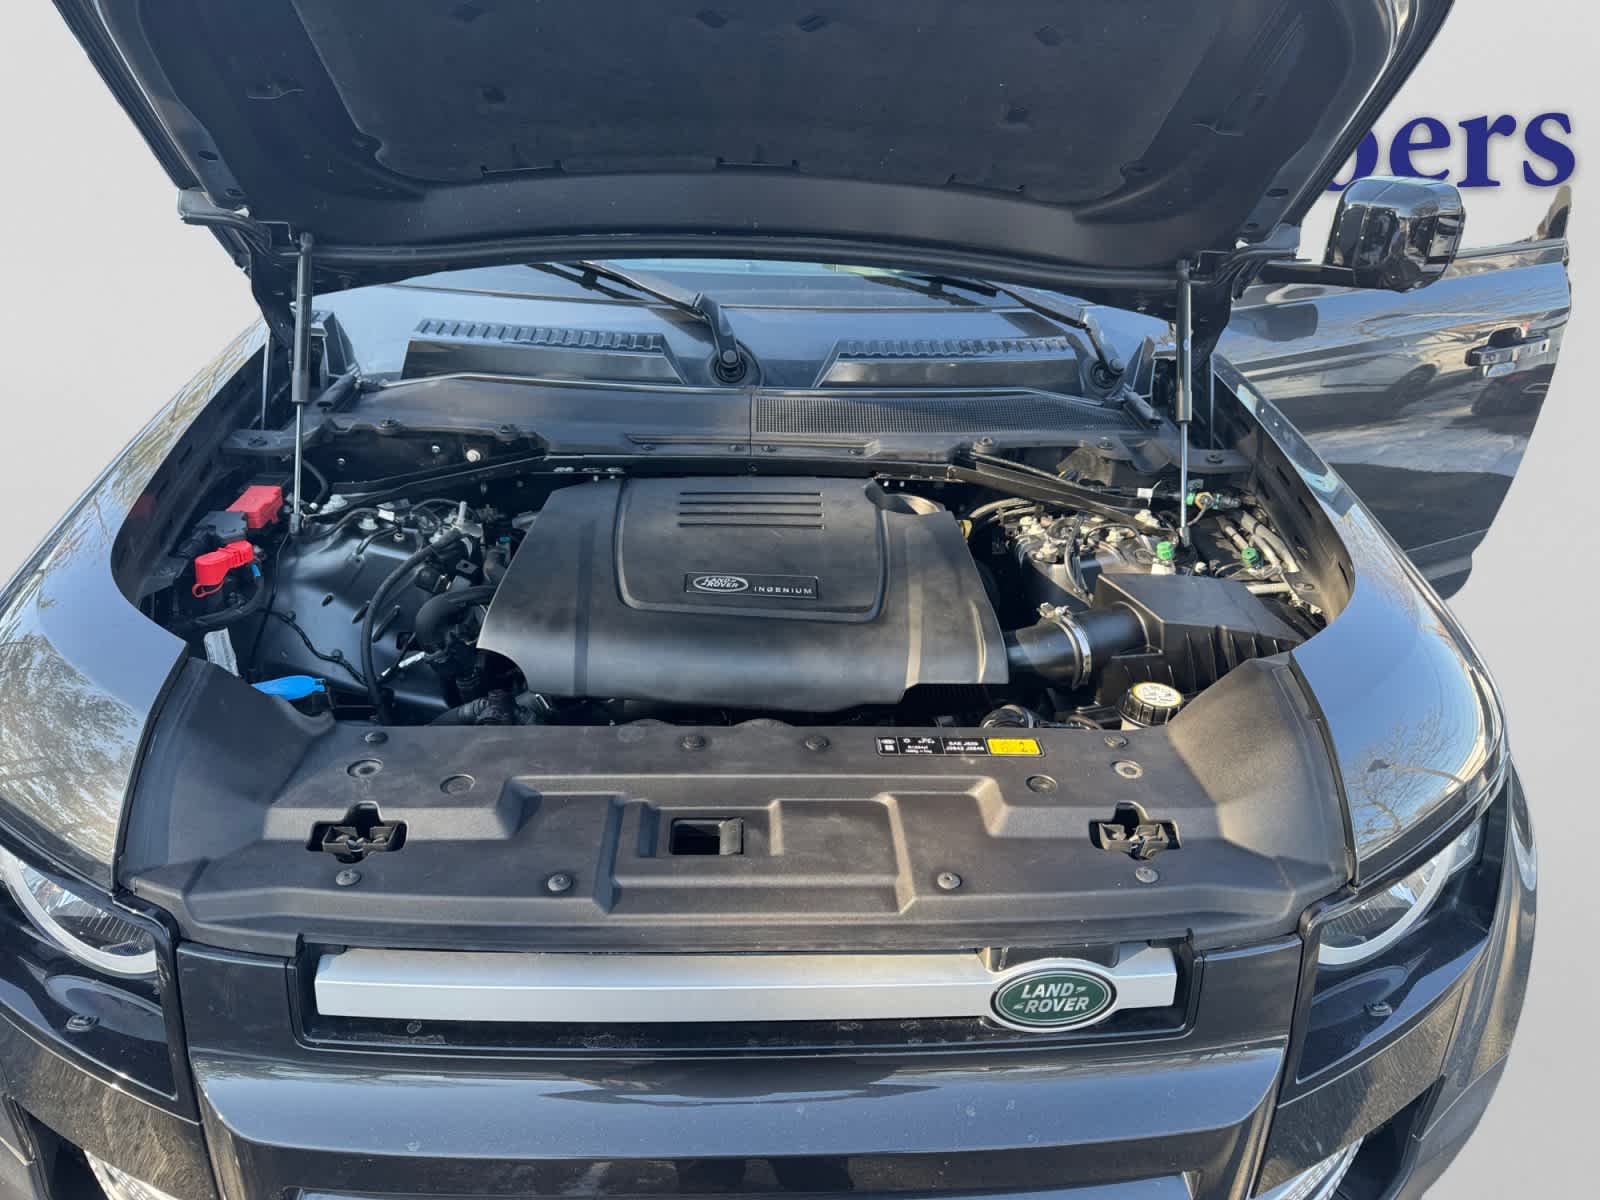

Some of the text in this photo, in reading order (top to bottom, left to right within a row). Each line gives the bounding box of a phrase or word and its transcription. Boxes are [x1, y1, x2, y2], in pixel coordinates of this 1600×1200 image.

[753, 585, 813, 594] INGENIUM
[1021, 983, 1074, 998] LAND
[1024, 997, 1089, 1013] ROVER
